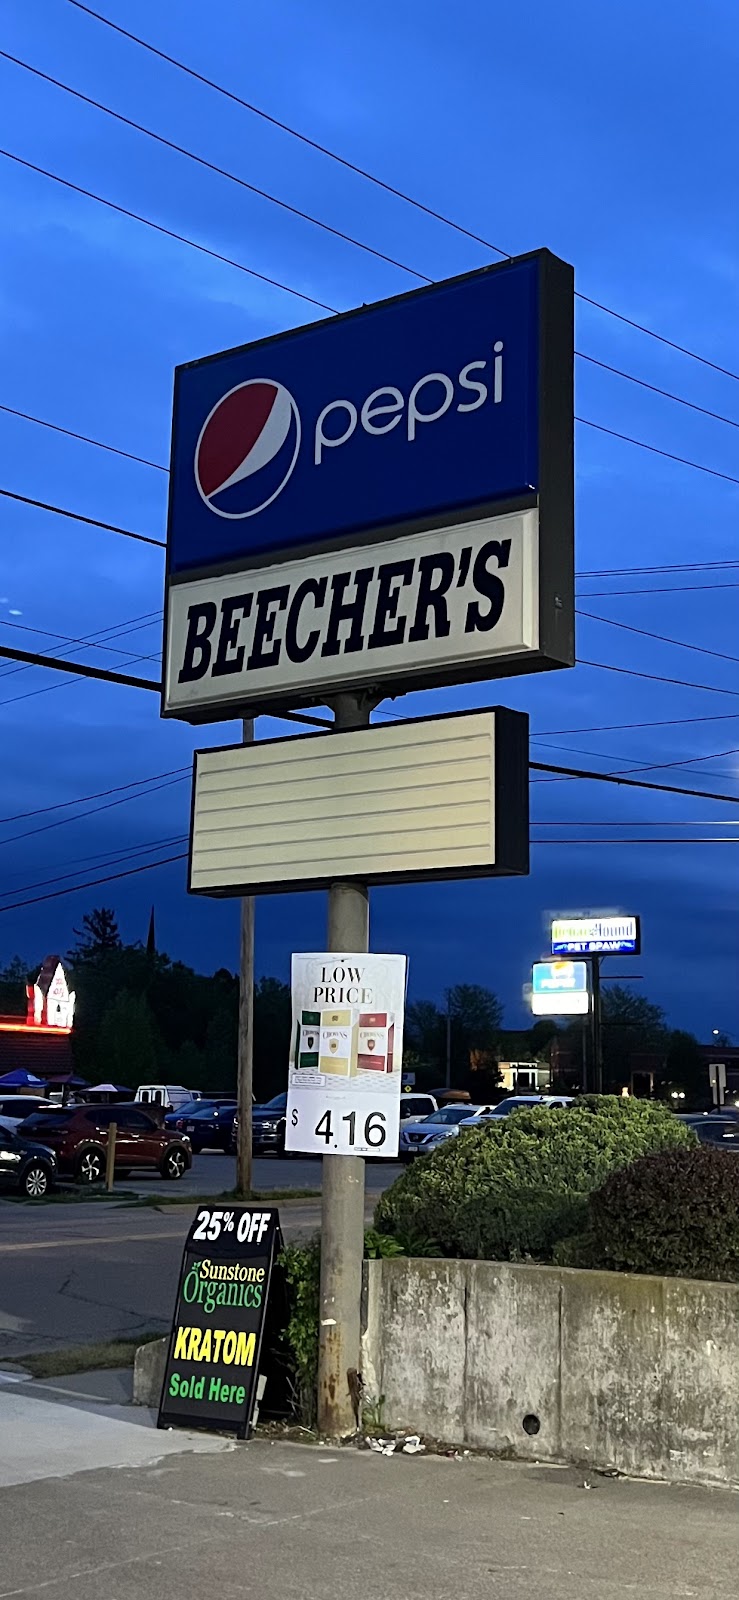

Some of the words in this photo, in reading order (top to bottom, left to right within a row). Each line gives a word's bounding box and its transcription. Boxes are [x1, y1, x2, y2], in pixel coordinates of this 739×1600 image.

[314, 340, 504, 466] pepsi
[177, 538, 512, 684] BEECHER'S
[567, 942, 587, 951] PET
[588, 941, 621, 950] SPAW
[321, 966, 365, 983] LOW
[313, 986, 373, 1005] PRICE
[322, 1030, 348, 1040] CROWNS
[315, 1109, 387, 1149] 4.16
[193, 1210, 234, 1241] 25%
[237, 1212, 271, 1243] OFF
[199, 1258, 266, 1283] Sunstone
[183, 1269, 263, 1314] Organics
[173, 1326, 257, 1367] KRATOM
[169, 1372, 206, 1400] Sold
[208, 1376, 246, 1405] Here
